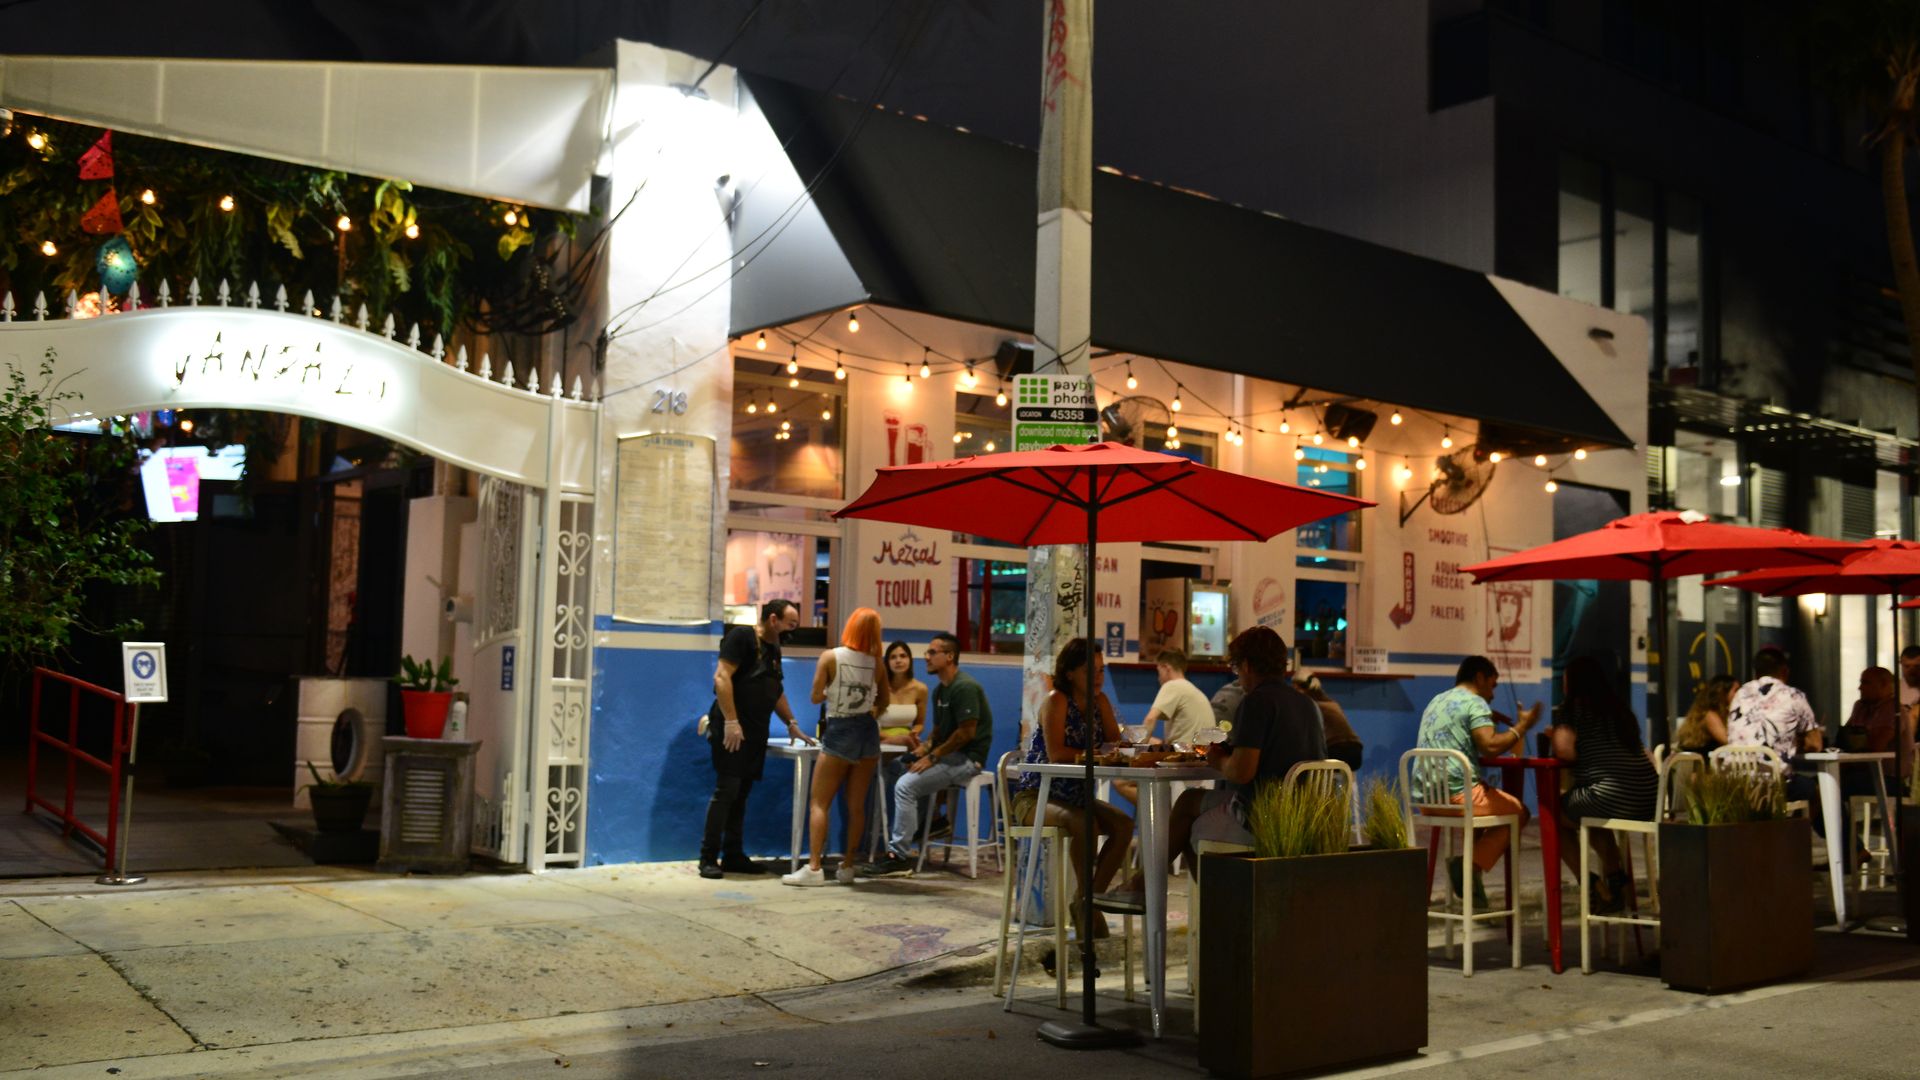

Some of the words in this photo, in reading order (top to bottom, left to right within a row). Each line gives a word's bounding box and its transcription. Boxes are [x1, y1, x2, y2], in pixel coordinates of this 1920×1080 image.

[651, 387, 688, 415] 218
[1053, 393, 1095, 405] phone
[1019, 425, 1055, 437] download
[1056, 426, 1080, 437] mobile
[873, 540, 941, 567] Mezcal
[875, 579, 933, 607] TEQUILA
[1430, 604, 1465, 621] PALETAS
